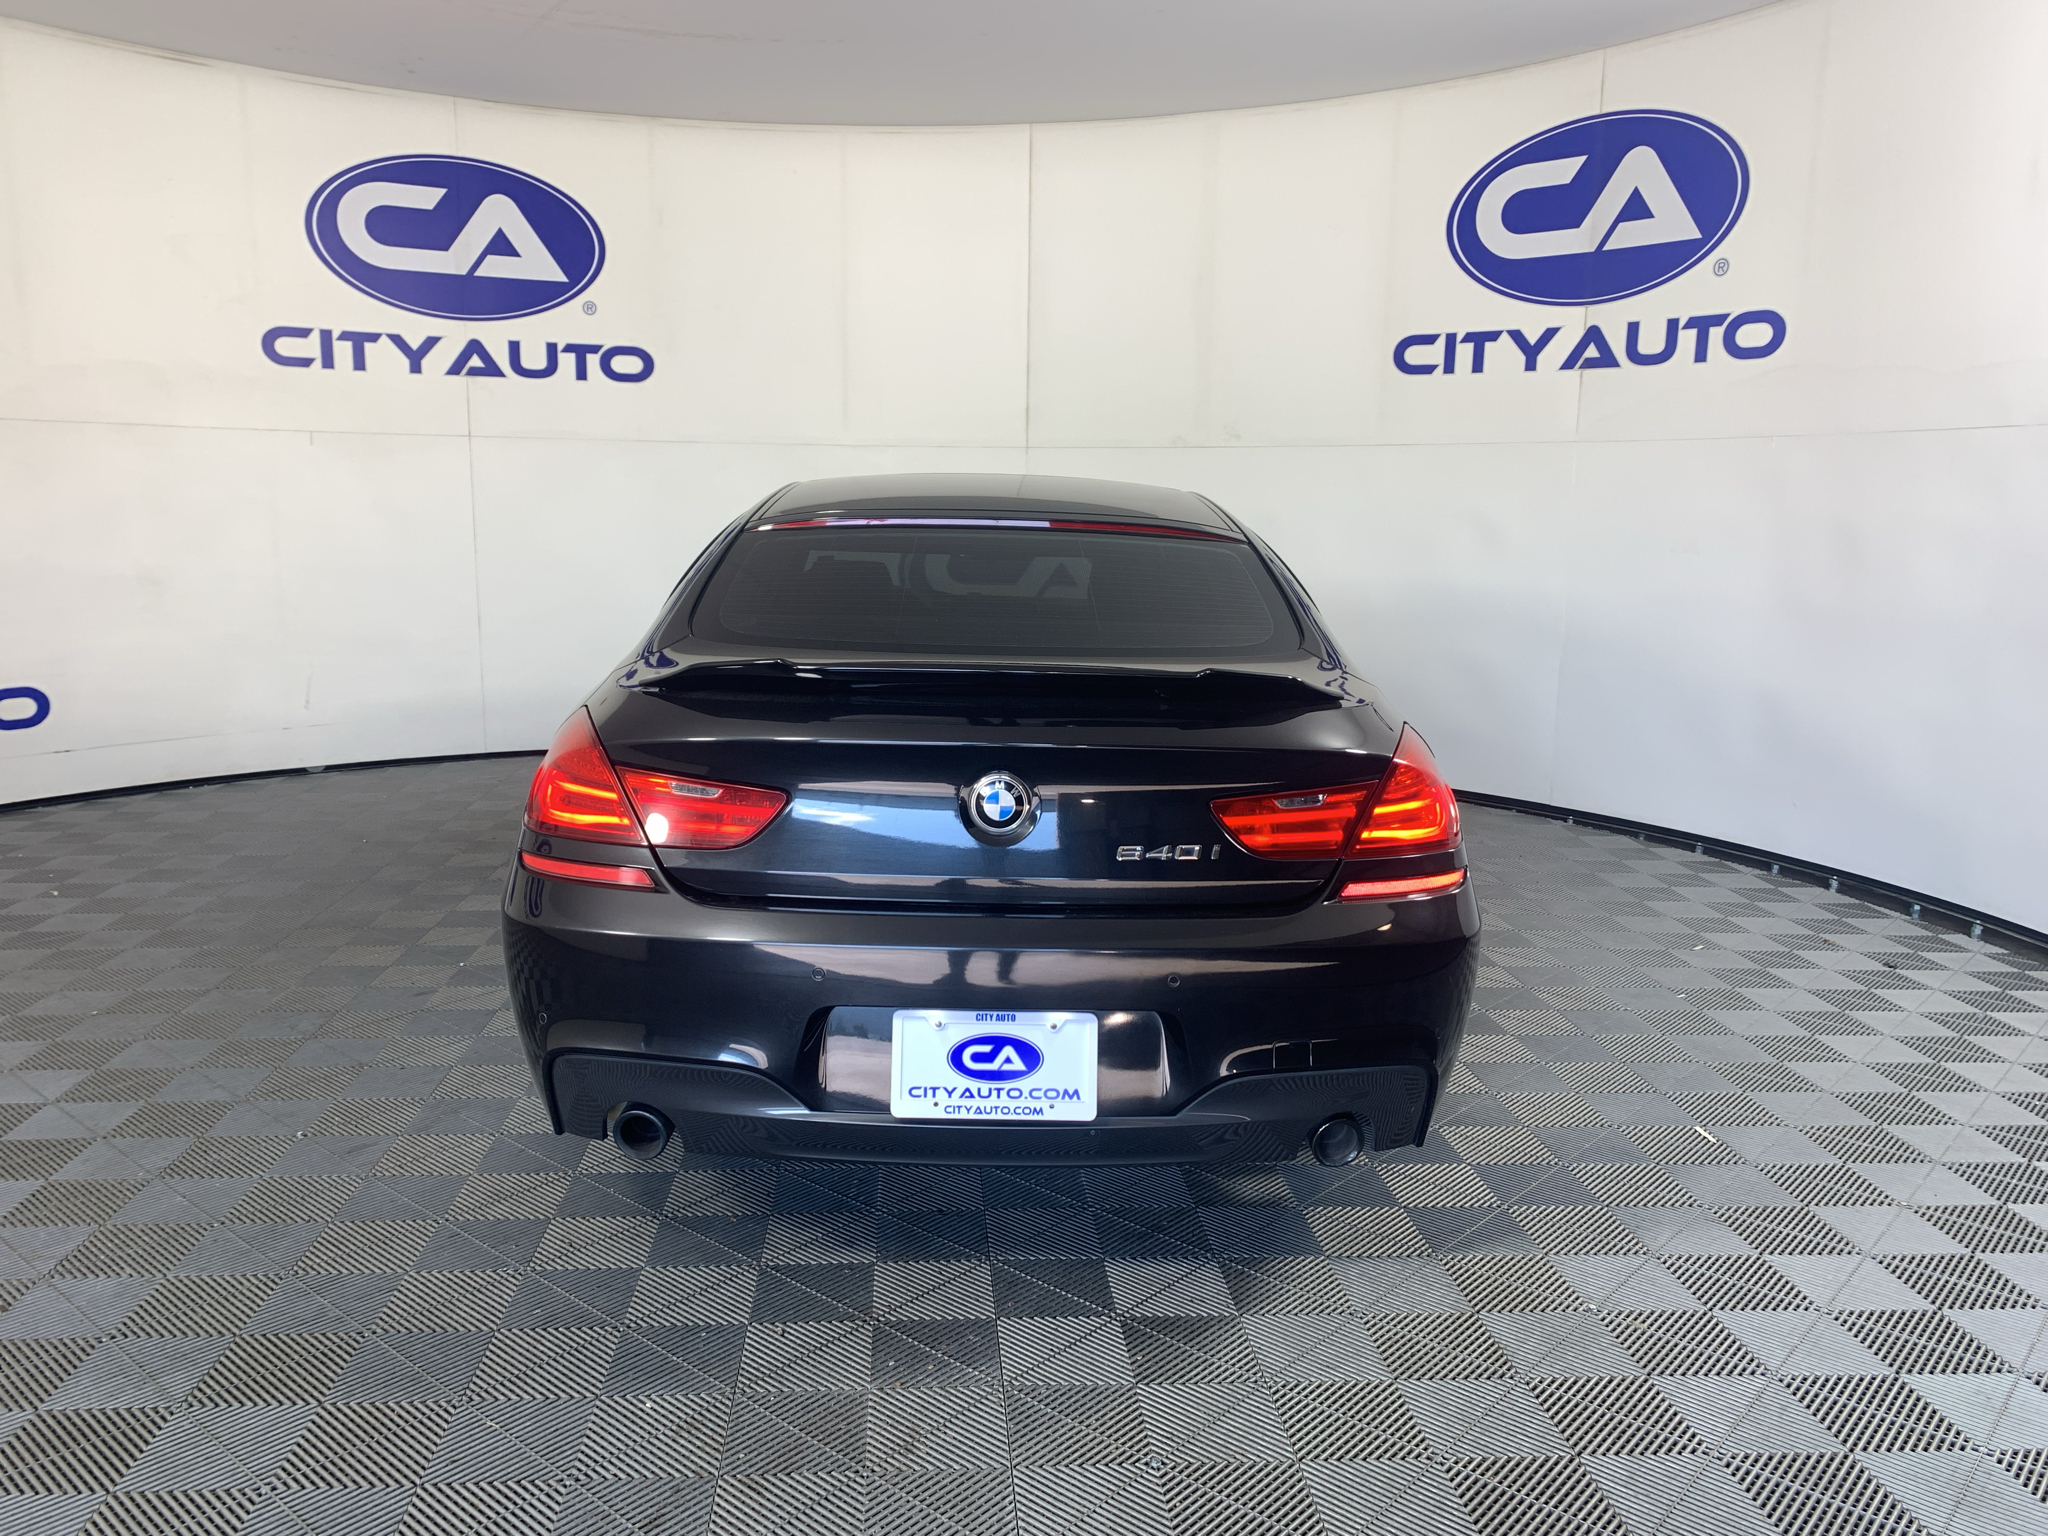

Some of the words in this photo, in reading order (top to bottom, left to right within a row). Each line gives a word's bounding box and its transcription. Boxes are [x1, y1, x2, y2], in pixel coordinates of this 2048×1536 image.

[1476, 145, 1703, 260] CA
[337, 181, 569, 282] CA
[975, 1012, 994, 1022] CITY
[995, 1013, 1016, 1023] AUTO
[962, 1044, 1029, 1071] CA
[908, 1085, 1081, 1101] CITYAUTO.COM
[944, 1105, 1044, 1116] CITYAUTO.COM
